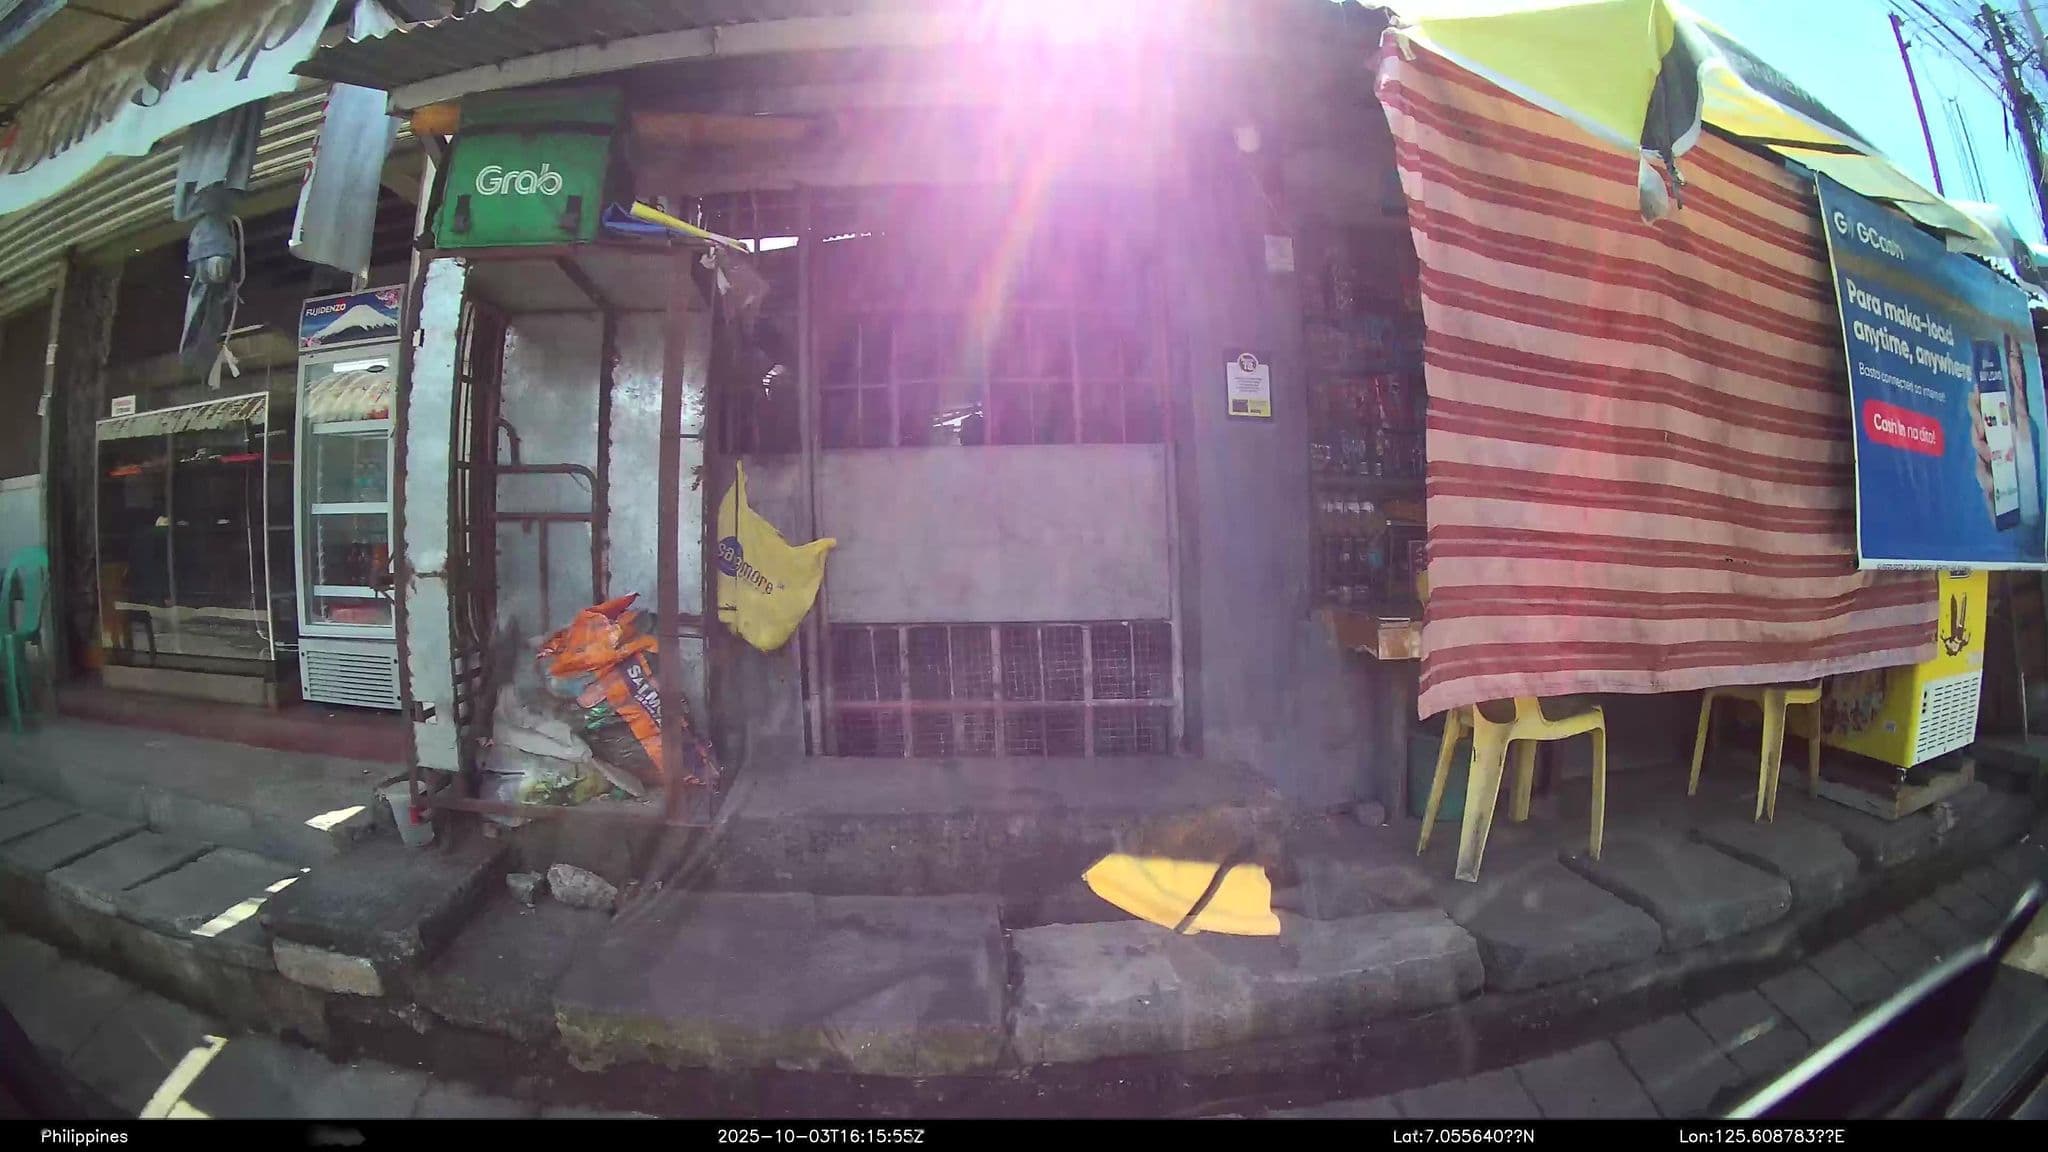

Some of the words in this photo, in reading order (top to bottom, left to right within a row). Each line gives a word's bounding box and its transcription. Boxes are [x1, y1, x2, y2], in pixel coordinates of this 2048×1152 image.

[476, 163, 563, 196] Grab
[1856, 222, 1905, 260] GCash
[305, 303, 346, 317] FUJIDENZO
[1846, 278, 1881, 316] Para
[1883, 301, 1954, 346] maka-load
[1853, 320, 1913, 365] anytime,
[1915, 345, 1972, 382] anywhere
[1858, 361, 1881, 380] Basta
[1873, 413, 1898, 435] Cash
[1907, 426, 1919, 440] na
